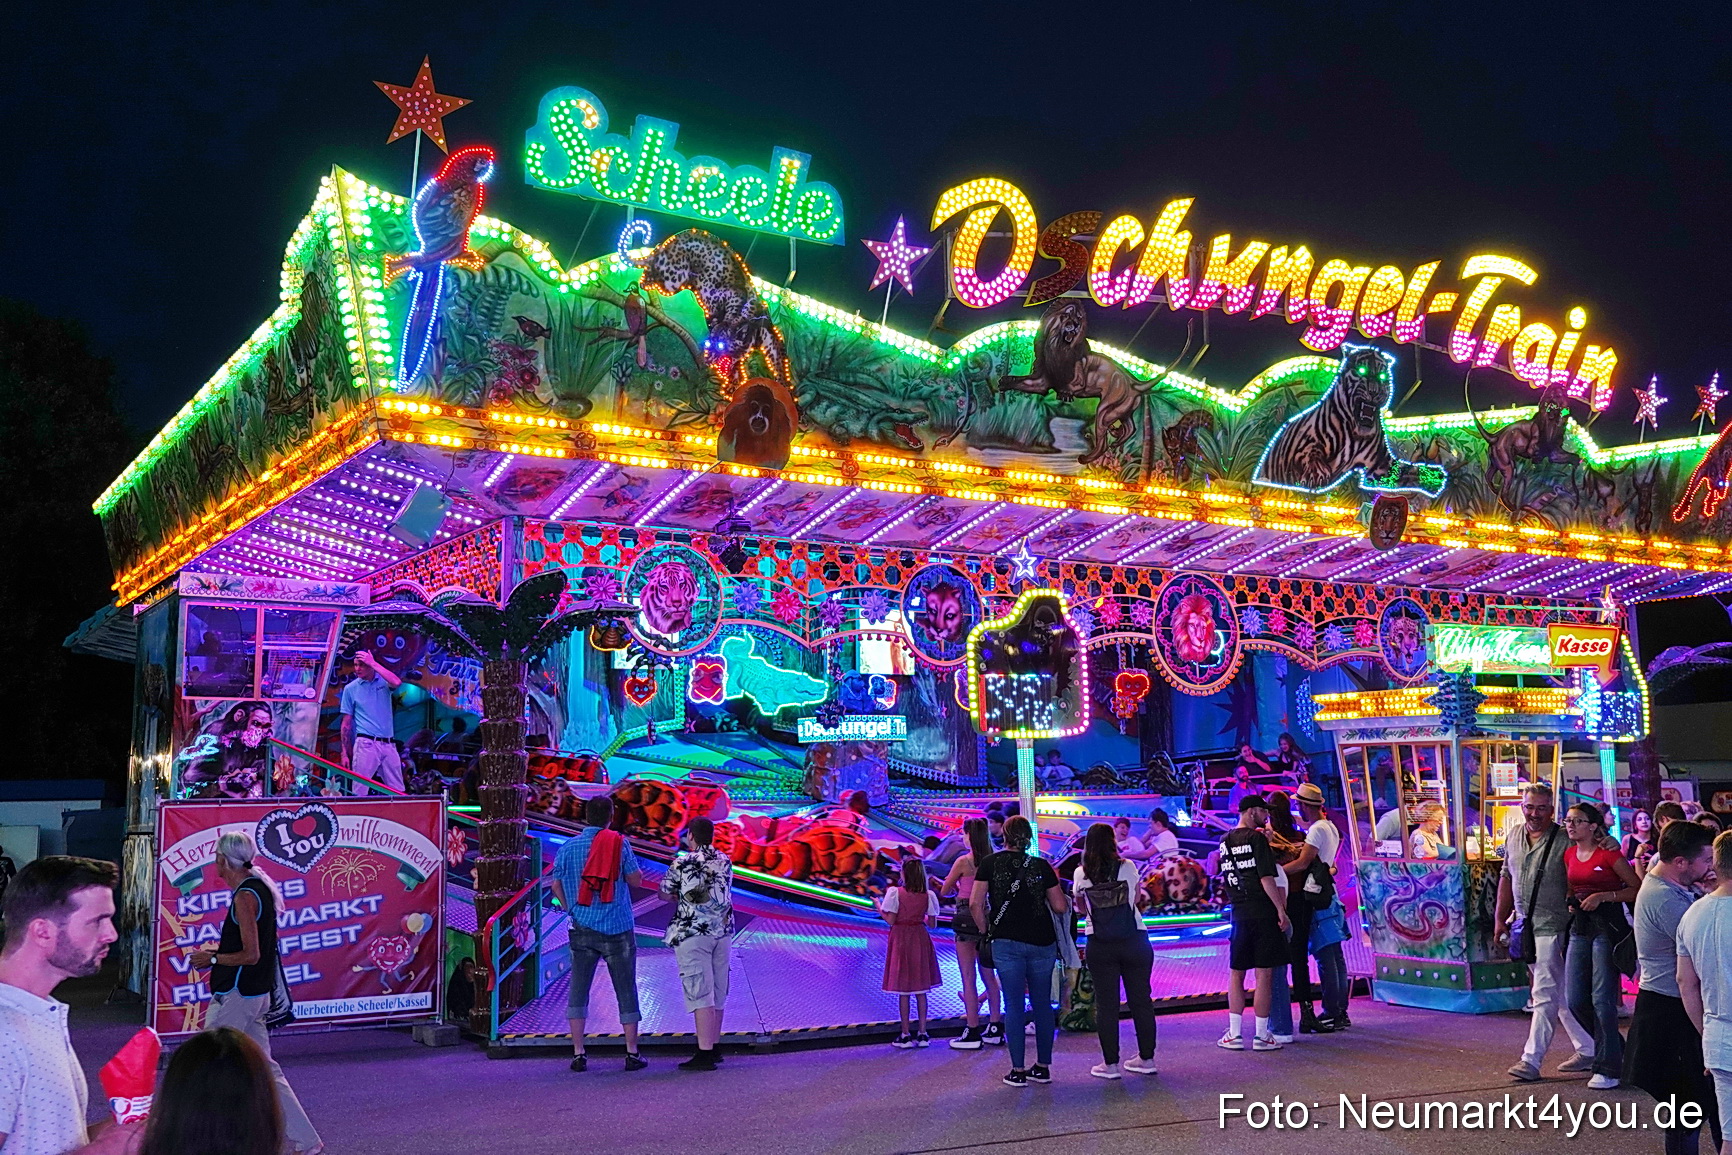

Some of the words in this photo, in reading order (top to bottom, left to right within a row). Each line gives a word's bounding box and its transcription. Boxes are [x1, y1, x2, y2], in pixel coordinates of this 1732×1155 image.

[525, 97, 842, 240] Scheele
[1557, 636, 1610, 655] Kasse
[274, 822, 293, 847] I
[283, 832, 325, 860] YOU
[339, 818, 440, 874] willkommen!
[178, 879, 305, 914] KIRS
[175, 895, 383, 945] JAMARKT
[169, 924, 363, 975] VFEST
[172, 963, 322, 1005] RUEL
[291, 1001, 355, 1018] ellerbetriebe
[357, 994, 428, 1014] Scheele/Kassel
